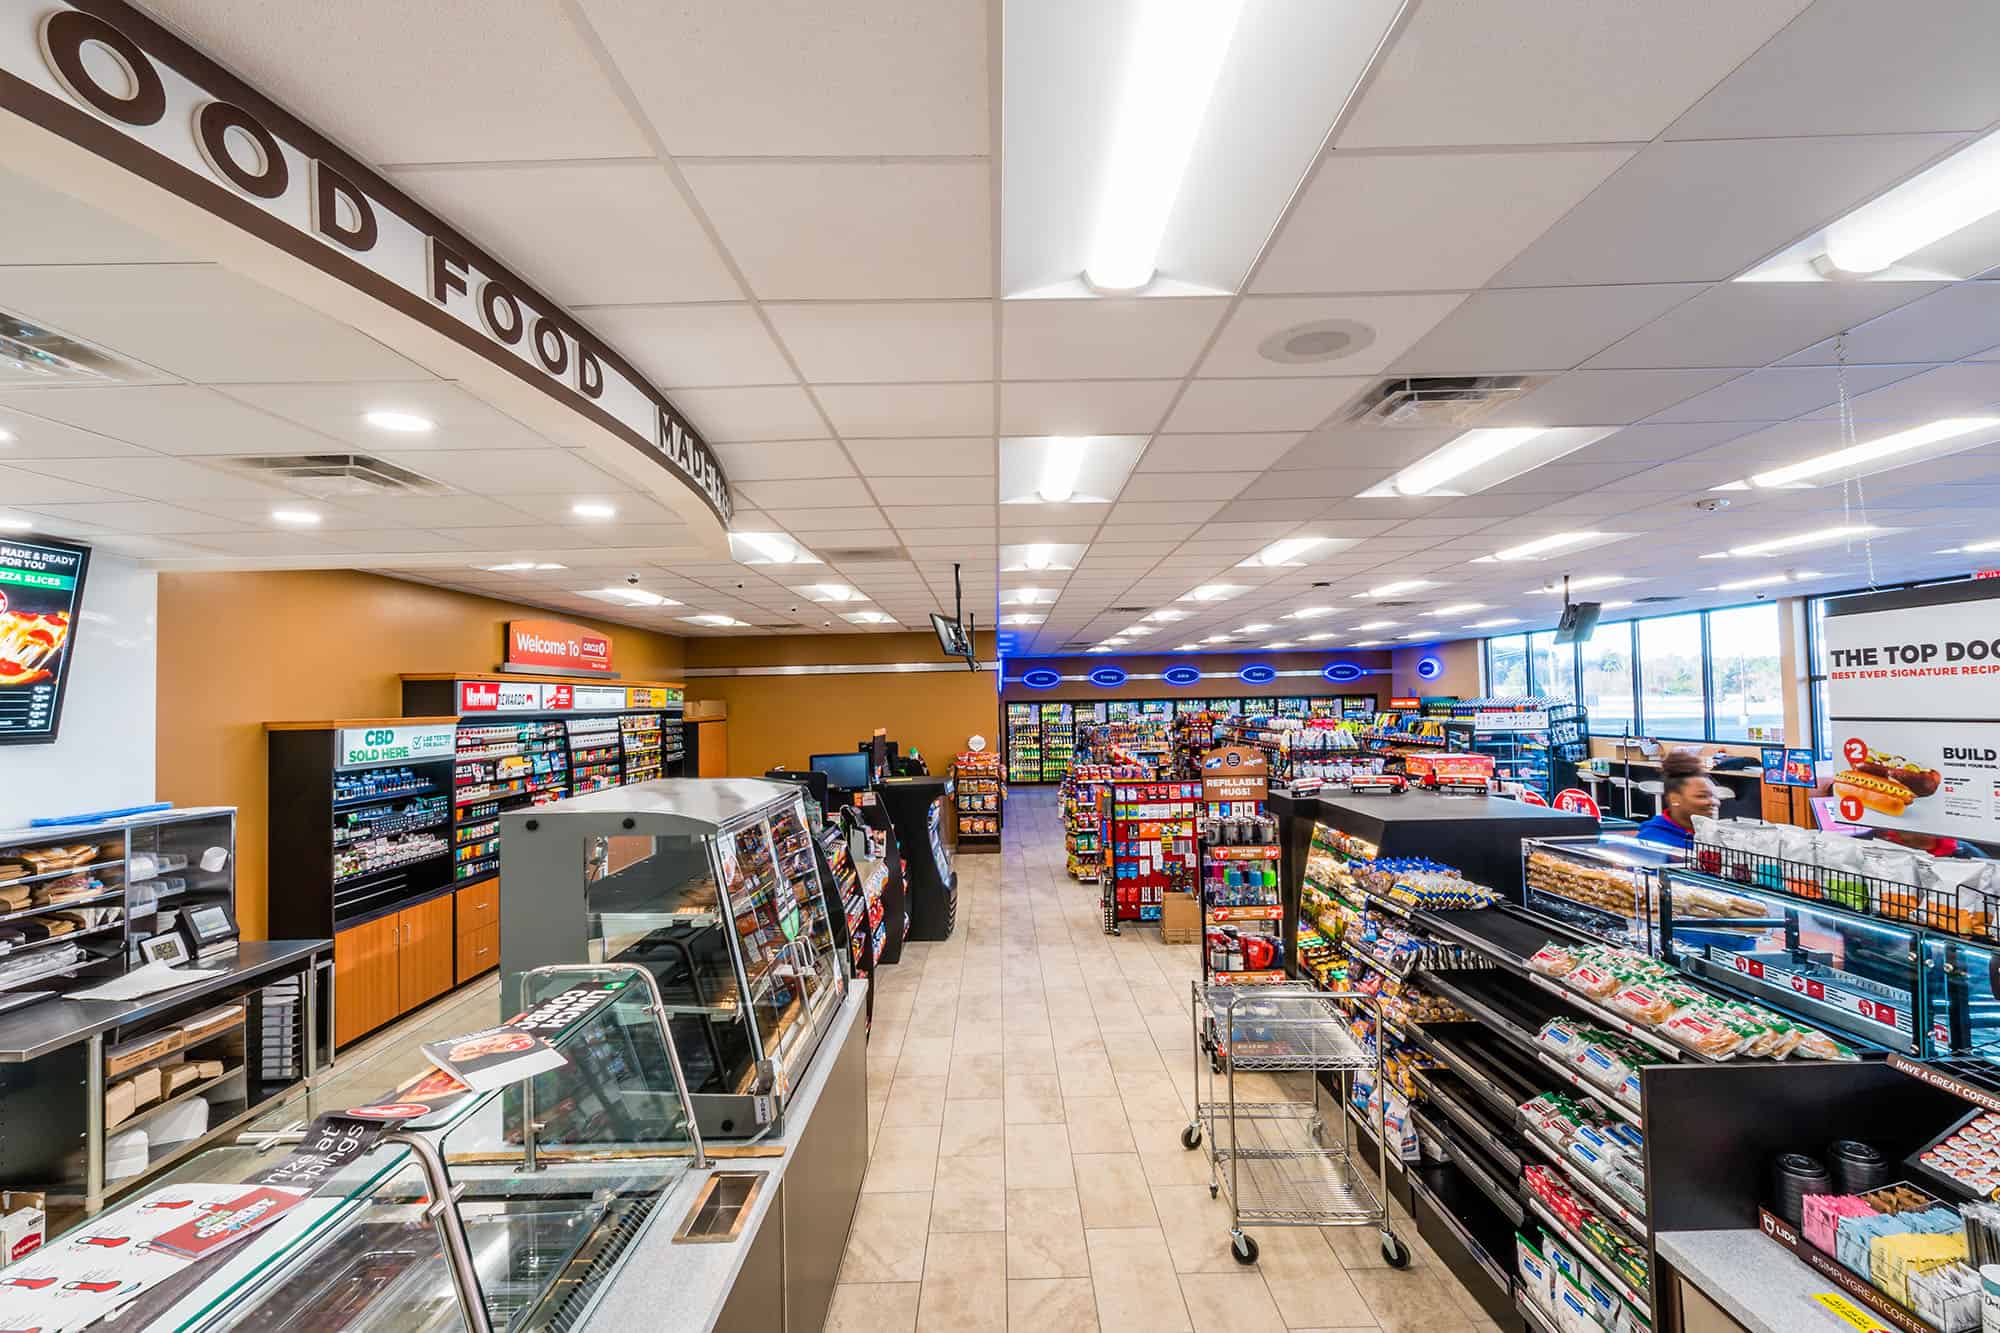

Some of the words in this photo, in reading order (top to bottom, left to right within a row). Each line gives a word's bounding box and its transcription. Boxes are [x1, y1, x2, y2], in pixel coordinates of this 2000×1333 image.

[426, 235, 604, 399] FOOD
[1, 546, 32, 559] MADE
[42, 553, 76, 565] READY
[24, 560, 46, 570] YOU
[25, 574, 61, 586] SLICES
[516, 631, 567, 656] Welcome
[568, 640, 580, 657] To
[1830, 647, 1878, 668] THE
[1883, 644, 1938, 665] TOP
[1831, 671, 1857, 680] BEST
[1859, 670, 1887, 679] EVER
[1890, 667, 1958, 678] SIGNATURE
[365, 730, 394, 747] CBD
[349, 749, 379, 763] SOLD
[382, 747, 409, 759] HERE
[1943, 747, 1997, 761] BUILD
[1206, 778, 1264, 787] REFILLABLE
[1220, 788, 1251, 796] MUGS!
[1896, 1060, 1920, 1075] HAVE
[1921, 1071, 1929, 1080] A
[1930, 1075, 1961, 1094] GREAT
[315, 1126, 341, 1151] at
[1776, 1225, 1797, 1245] LIDS
